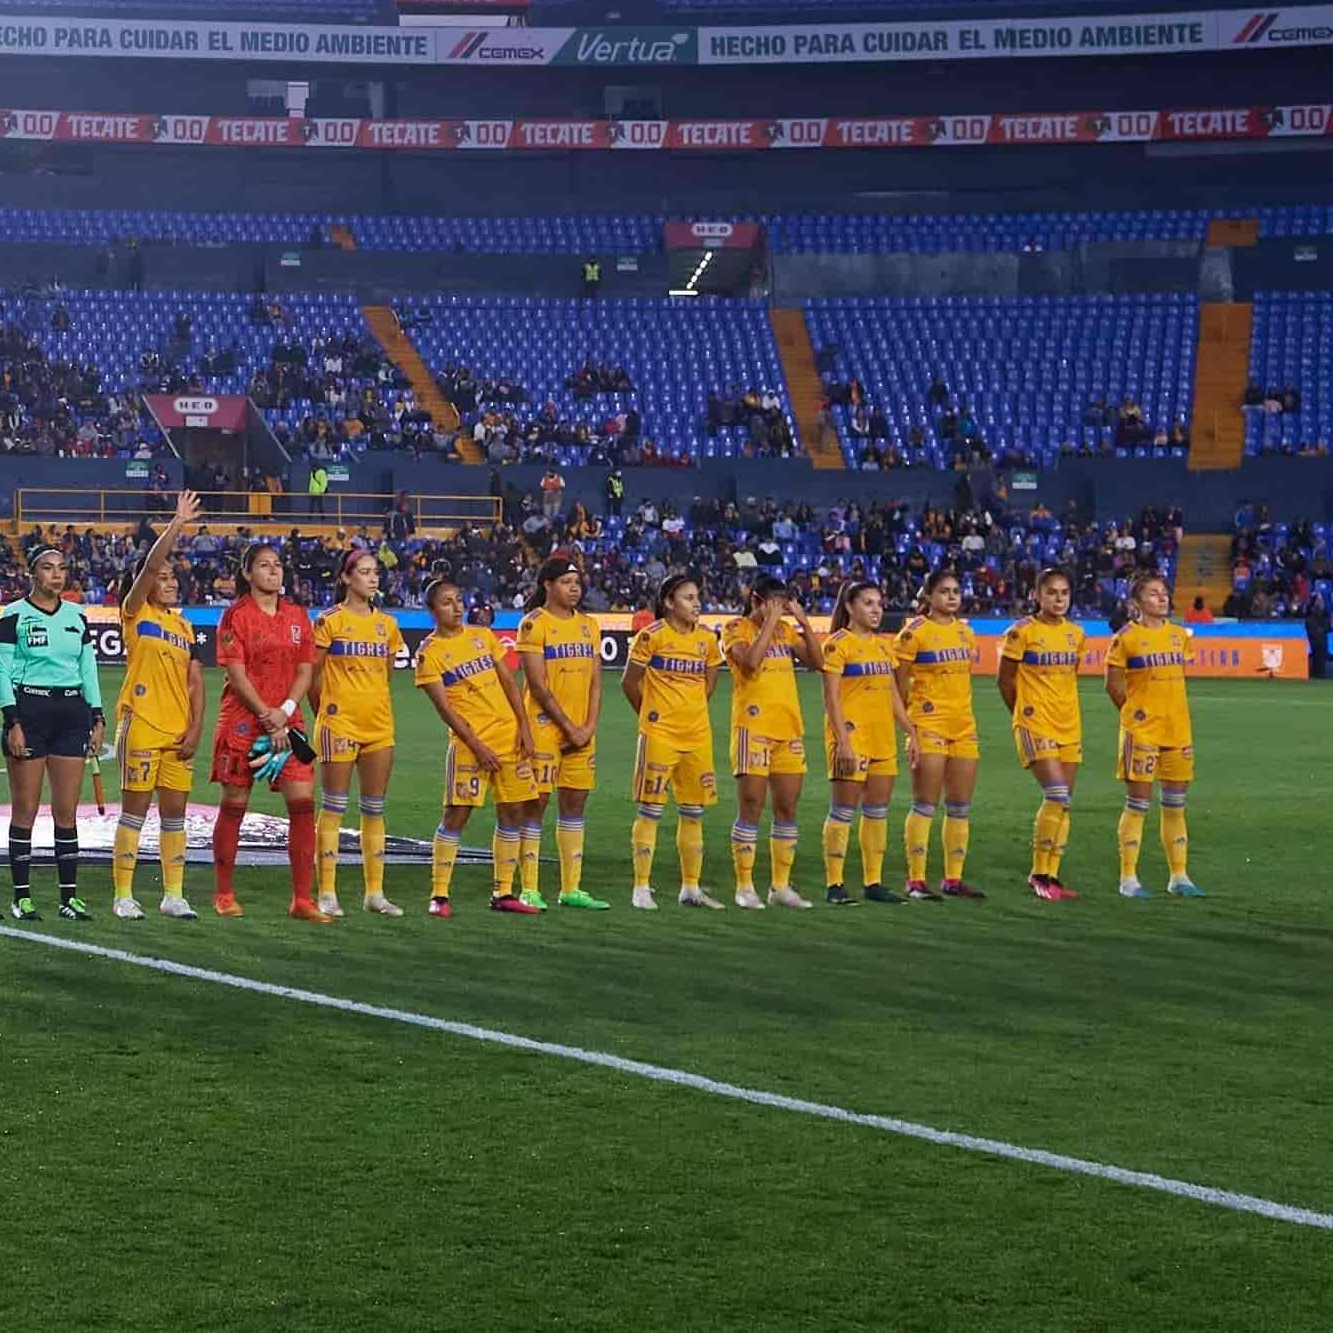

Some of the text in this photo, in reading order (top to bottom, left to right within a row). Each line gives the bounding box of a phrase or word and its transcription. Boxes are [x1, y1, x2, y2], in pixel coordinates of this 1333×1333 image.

[54, 27, 113, 50] PARA
[119, 28, 200, 52] CUIDAR
[209, 30, 233, 52] EL
[240, 31, 310, 54] MEDIO
[315, 33, 428, 57] AMBIENTE
[576, 35, 677, 62] Vertua
[710, 22, 1204, 57] HECHO PARA CUIDAR EL MEDIO AMBIENTE
[478, 46, 545, 59] CEMEX
[68, 116, 139, 139] TECATE
[218, 119, 288, 142] TECATE
[369, 123, 440, 145] TECATE
[520, 122, 593, 144] TECATE
[677, 122, 753, 144] TECATE
[837, 121, 913, 144] TECATE
[998, 117, 1078, 140] TECATE
[1167, 112, 1250, 136] TECATE
[469, 777, 480, 798] 9
